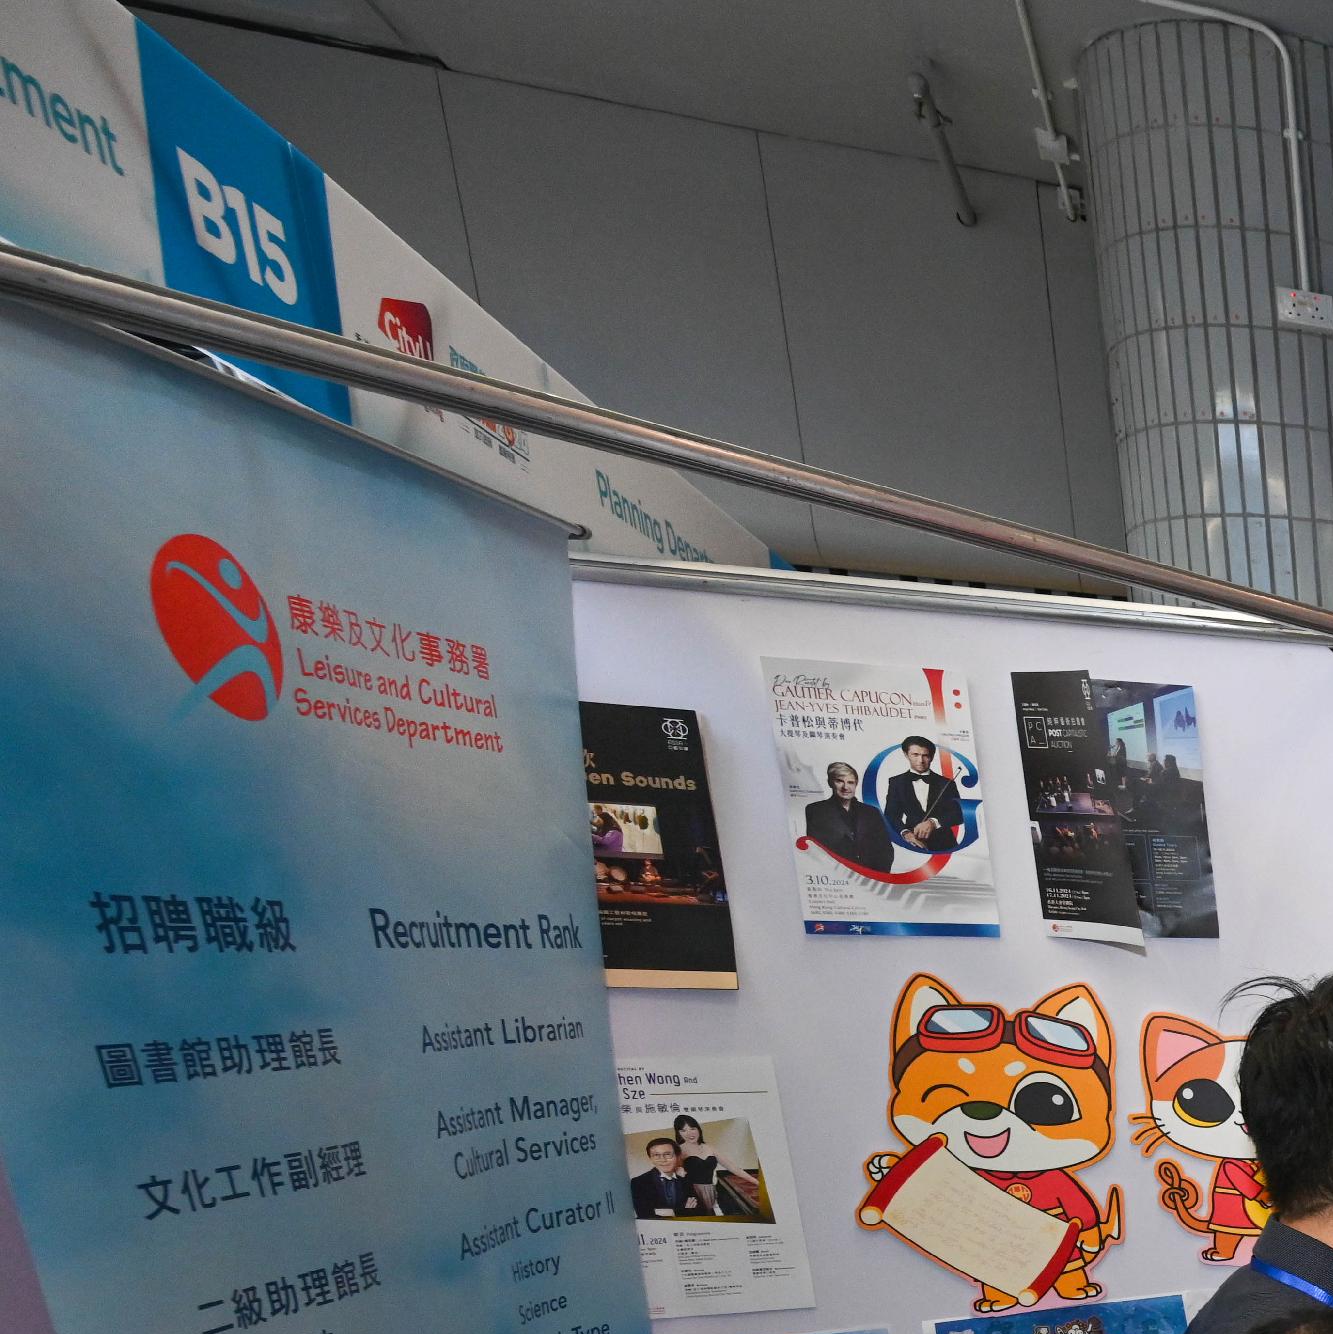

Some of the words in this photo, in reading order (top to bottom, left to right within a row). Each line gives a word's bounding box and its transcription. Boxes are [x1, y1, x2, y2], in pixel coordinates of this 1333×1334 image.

[0, 55, 125, 176] ment
[176, 144, 298, 305] B15
[595, 468, 663, 551] Planning
[287, 594, 490, 681] 康樂及文化事務署
[296, 647, 373, 692] Leisure
[378, 674, 411, 701] and
[418, 677, 498, 719] Cultural
[772, 684, 836, 700] GAUTIER
[774, 699, 840, 714] JEAN-YVES
[845, 703, 913, 719] THIBAUDET
[294, 687, 382, 730] Services
[384, 706, 503, 753] Department
[621, 770, 698, 792] Sounds
[90, 891, 297, 956] 招聘職級
[369, 907, 532, 952] Recruitment
[538, 910, 583, 951] Rank
[95, 1026, 343, 1089] 圖書館助理館長
[420, 1021, 493, 1054] Assistant
[500, 1016, 584, 1047] Librarian
[622, 1087, 646, 1101] Sze
[646, 1072, 681, 1087] Wong
[437, 1099, 504, 1140] Assistant
[509, 1090, 598, 1126] Manager,
[138, 1140, 369, 1221] 文化工作副經理
[453, 1140, 512, 1182] Cultural
[514, 1127, 598, 1158] Services
[460, 1213, 521, 1262] Assistant
[525, 1201, 602, 1233] Curator
[511, 1252, 562, 1284] History
[518, 1292, 569, 1326] Science
